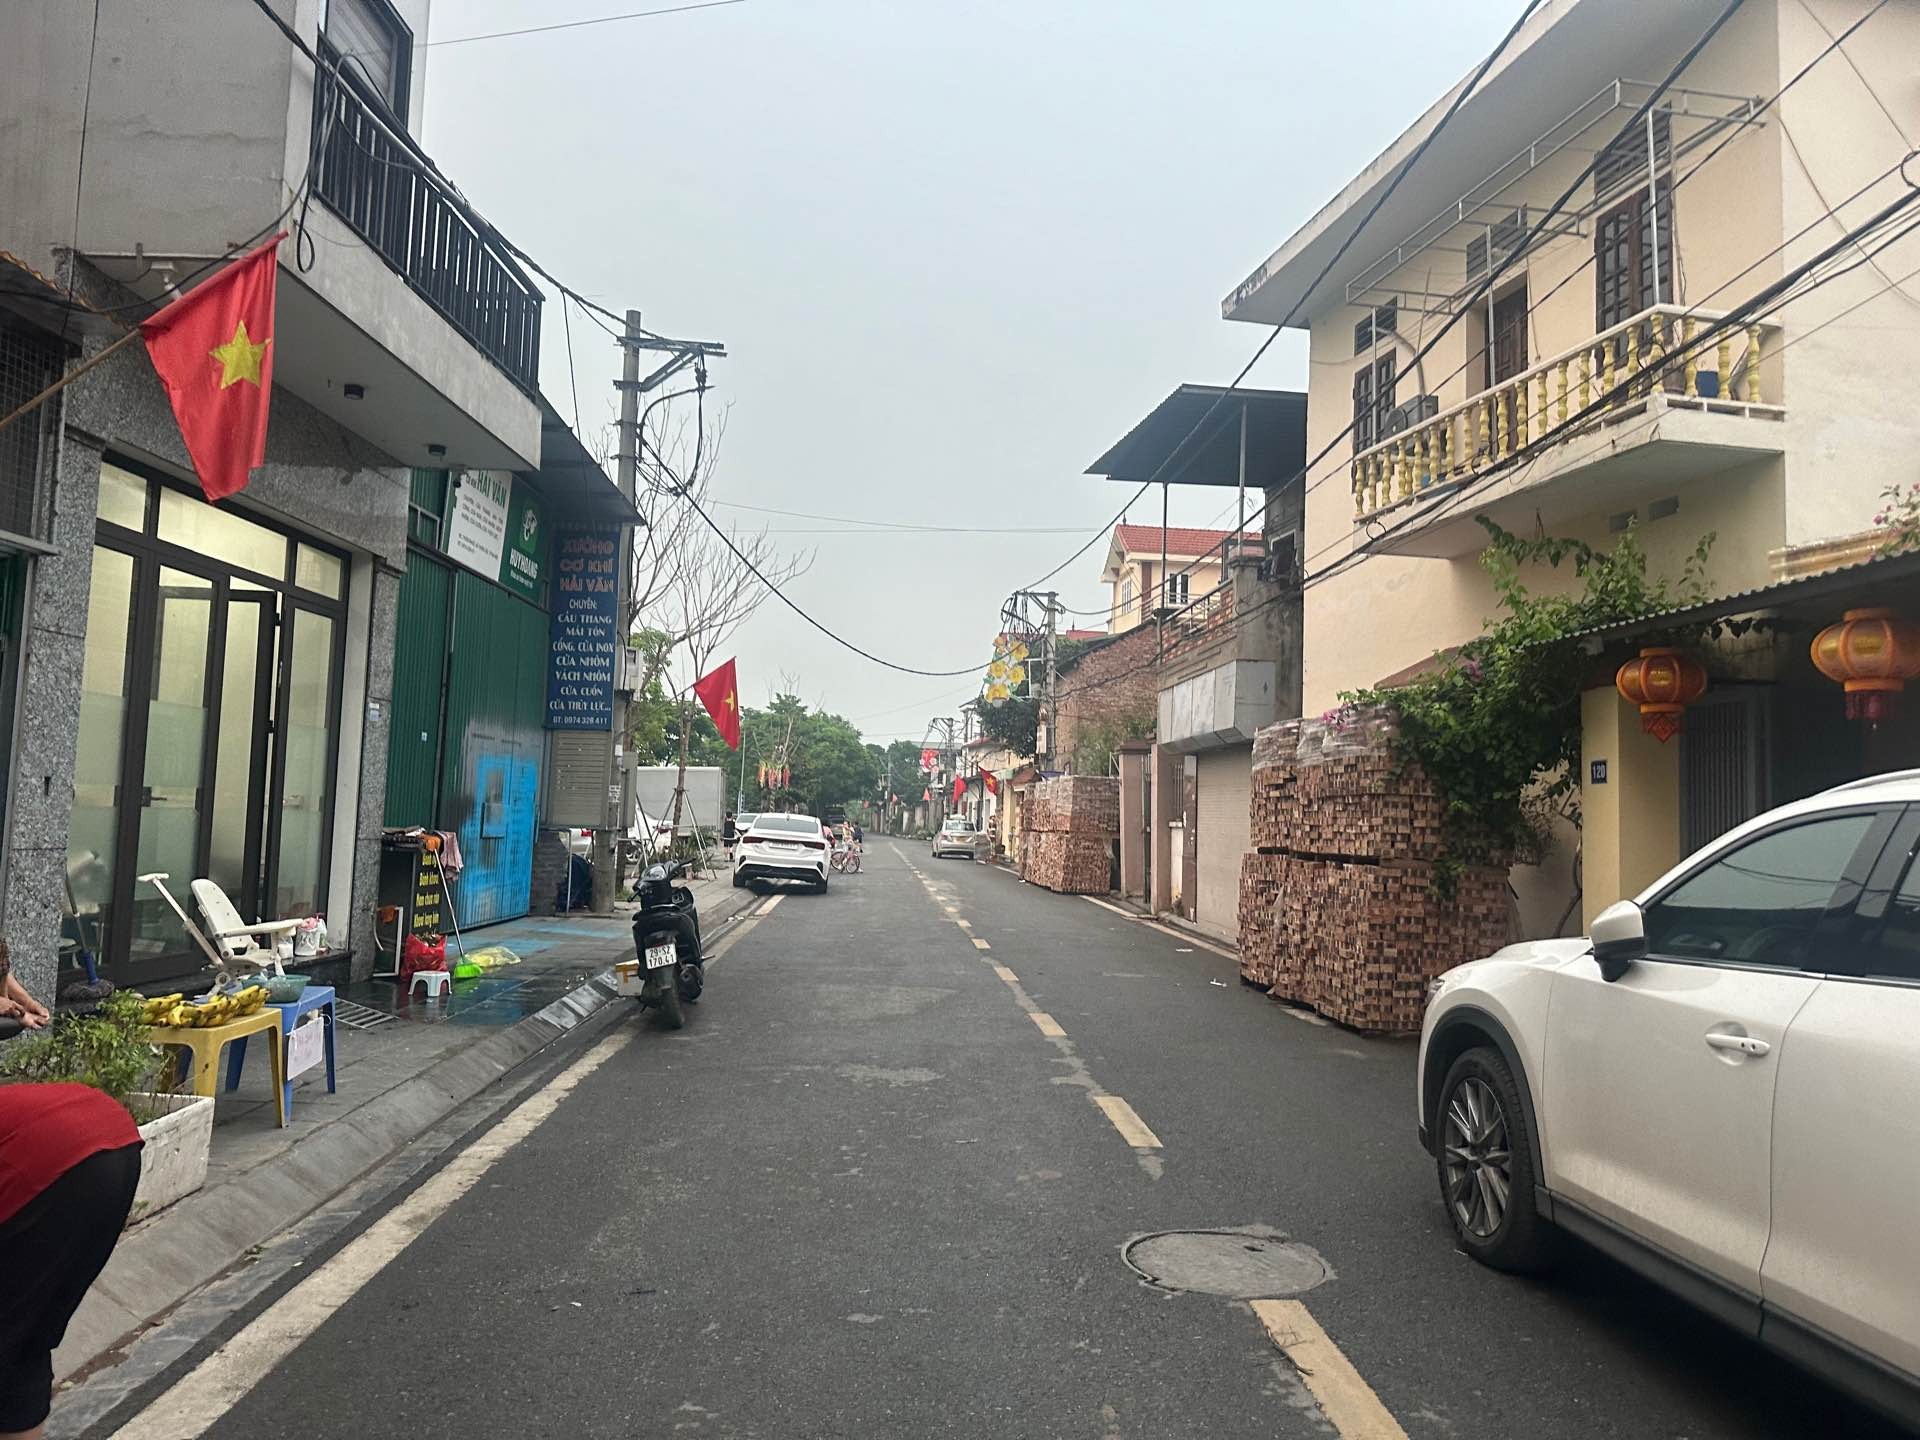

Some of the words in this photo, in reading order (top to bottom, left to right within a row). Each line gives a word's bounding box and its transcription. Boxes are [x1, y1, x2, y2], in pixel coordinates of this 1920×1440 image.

[559, 558, 584, 572] CƠ
[588, 558, 614, 573] KHÍ
[559, 574, 582, 592] HẢI
[580, 614, 612, 624] THANG
[566, 624, 584, 636] MÁI
[578, 640, 593, 652] CỬA
[596, 642, 614, 653] INOX
[556, 654, 576, 666] CỬA
[555, 669, 580, 681] VÁCH
[560, 684, 578, 696] CỬA
[549, 698, 565, 710] CỬA
